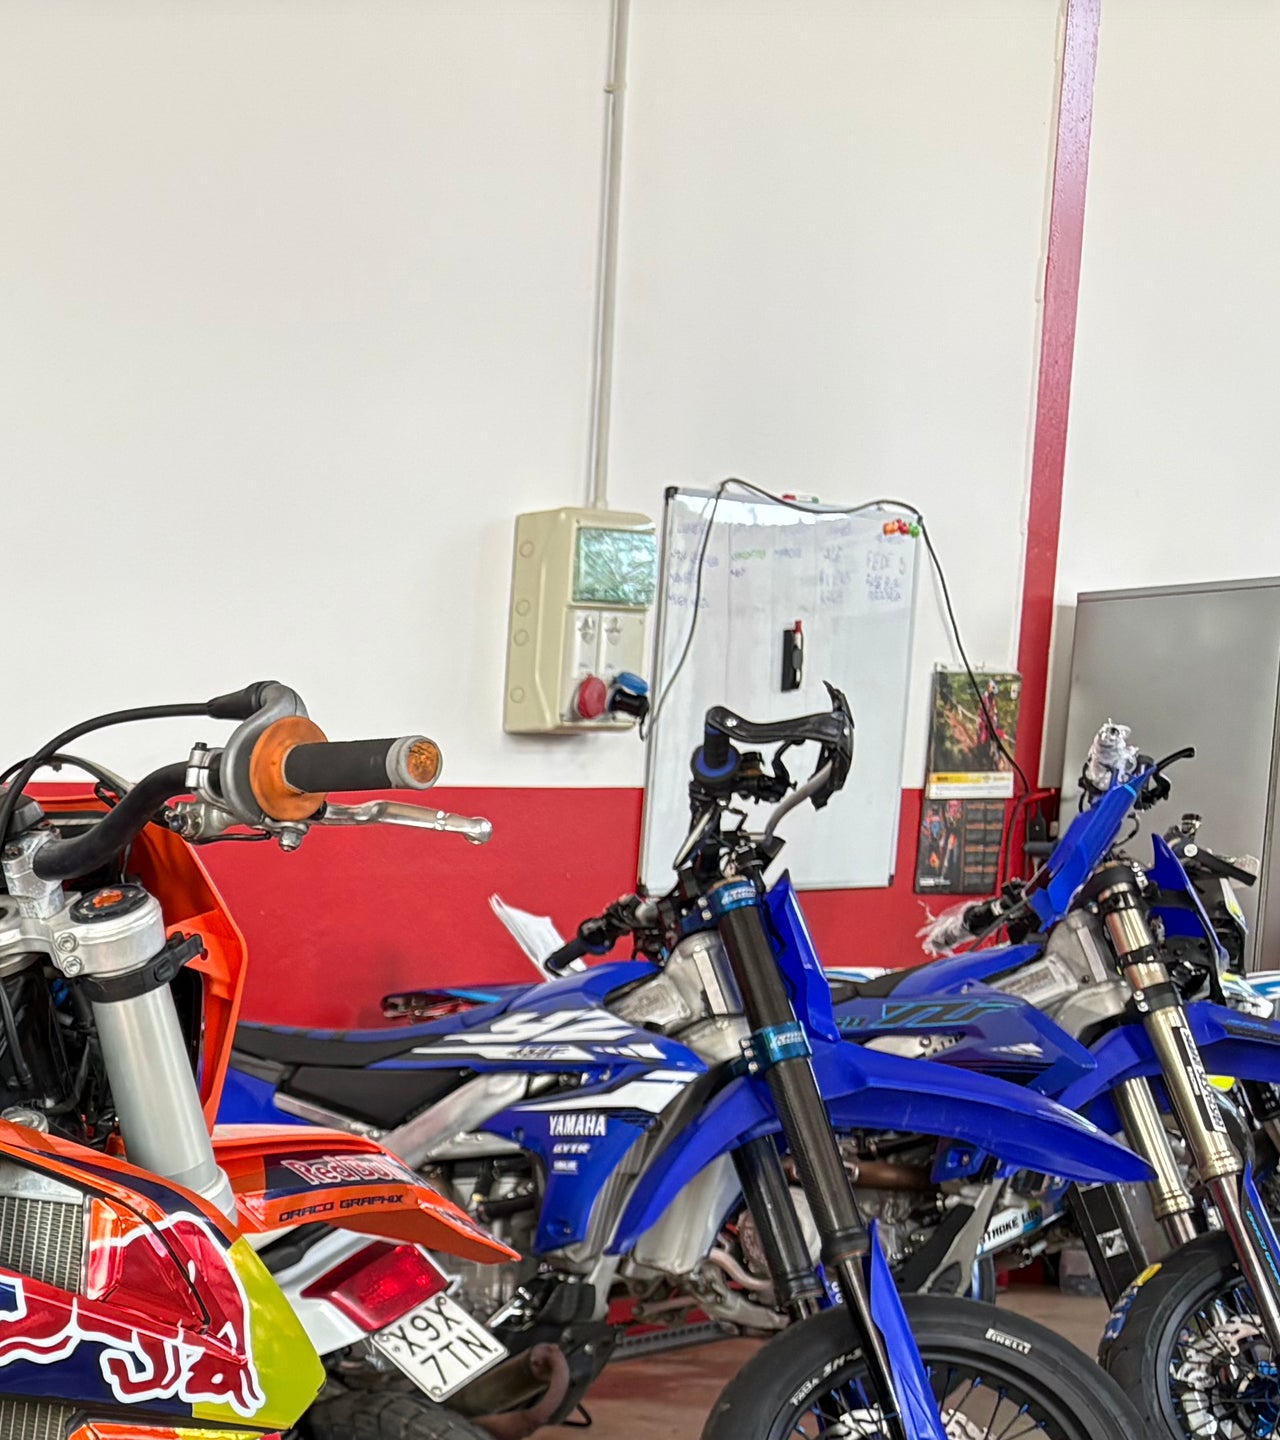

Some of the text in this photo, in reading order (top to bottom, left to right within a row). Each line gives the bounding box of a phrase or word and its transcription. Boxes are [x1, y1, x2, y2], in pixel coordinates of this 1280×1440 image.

[549, 1115, 607, 1136] YAMAHA
[279, 1194, 404, 1222] DRACO GRAPHIX
[391, 1302, 461, 1357] X9X
[420, 1329, 493, 1386] 7TN
